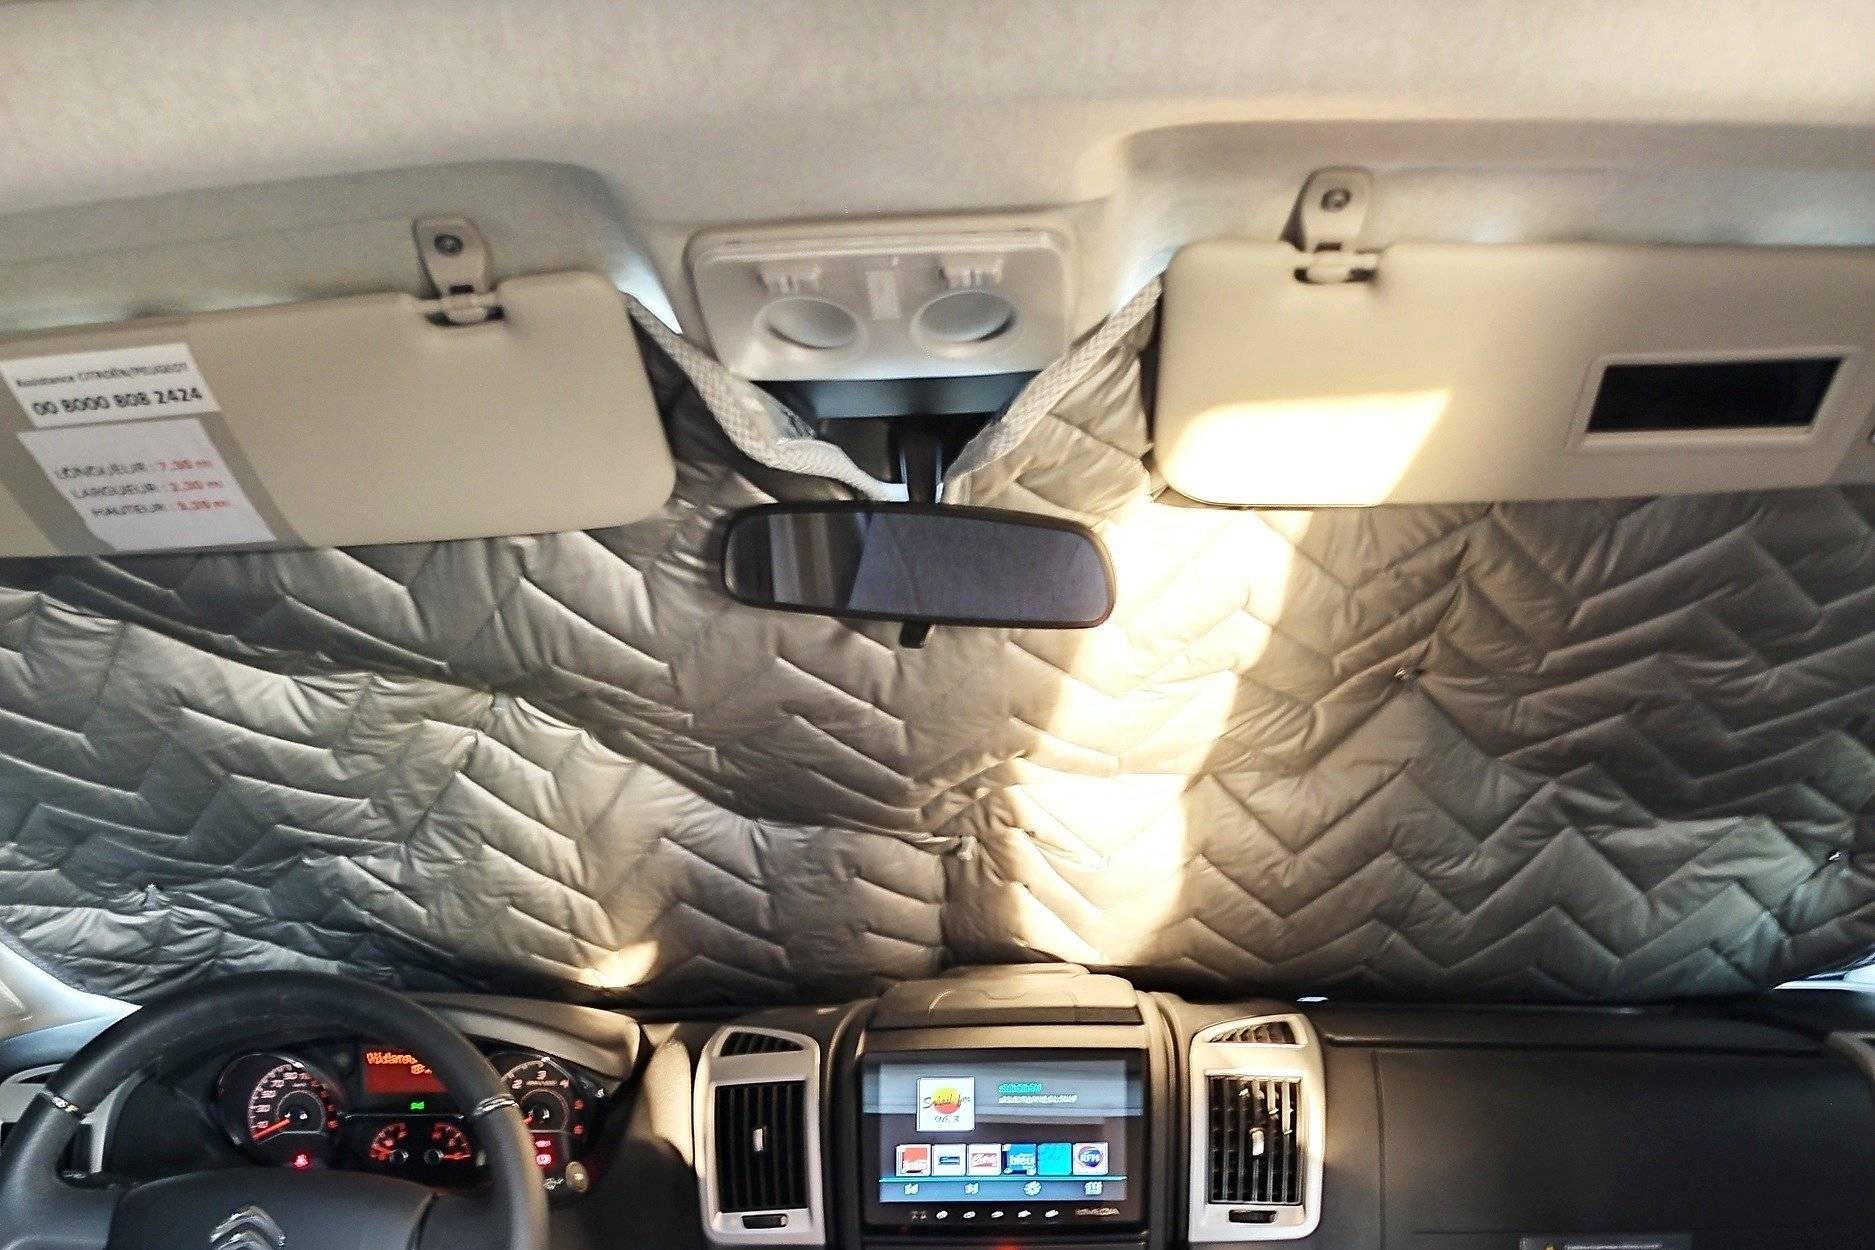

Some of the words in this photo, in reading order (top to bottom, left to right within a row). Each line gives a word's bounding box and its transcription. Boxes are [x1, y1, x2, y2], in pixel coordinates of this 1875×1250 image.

[32, 400, 59, 416] 00
[61, 395, 111, 413] 8000
[113, 391, 151, 408] 808
[153, 387, 203, 405] 2424
